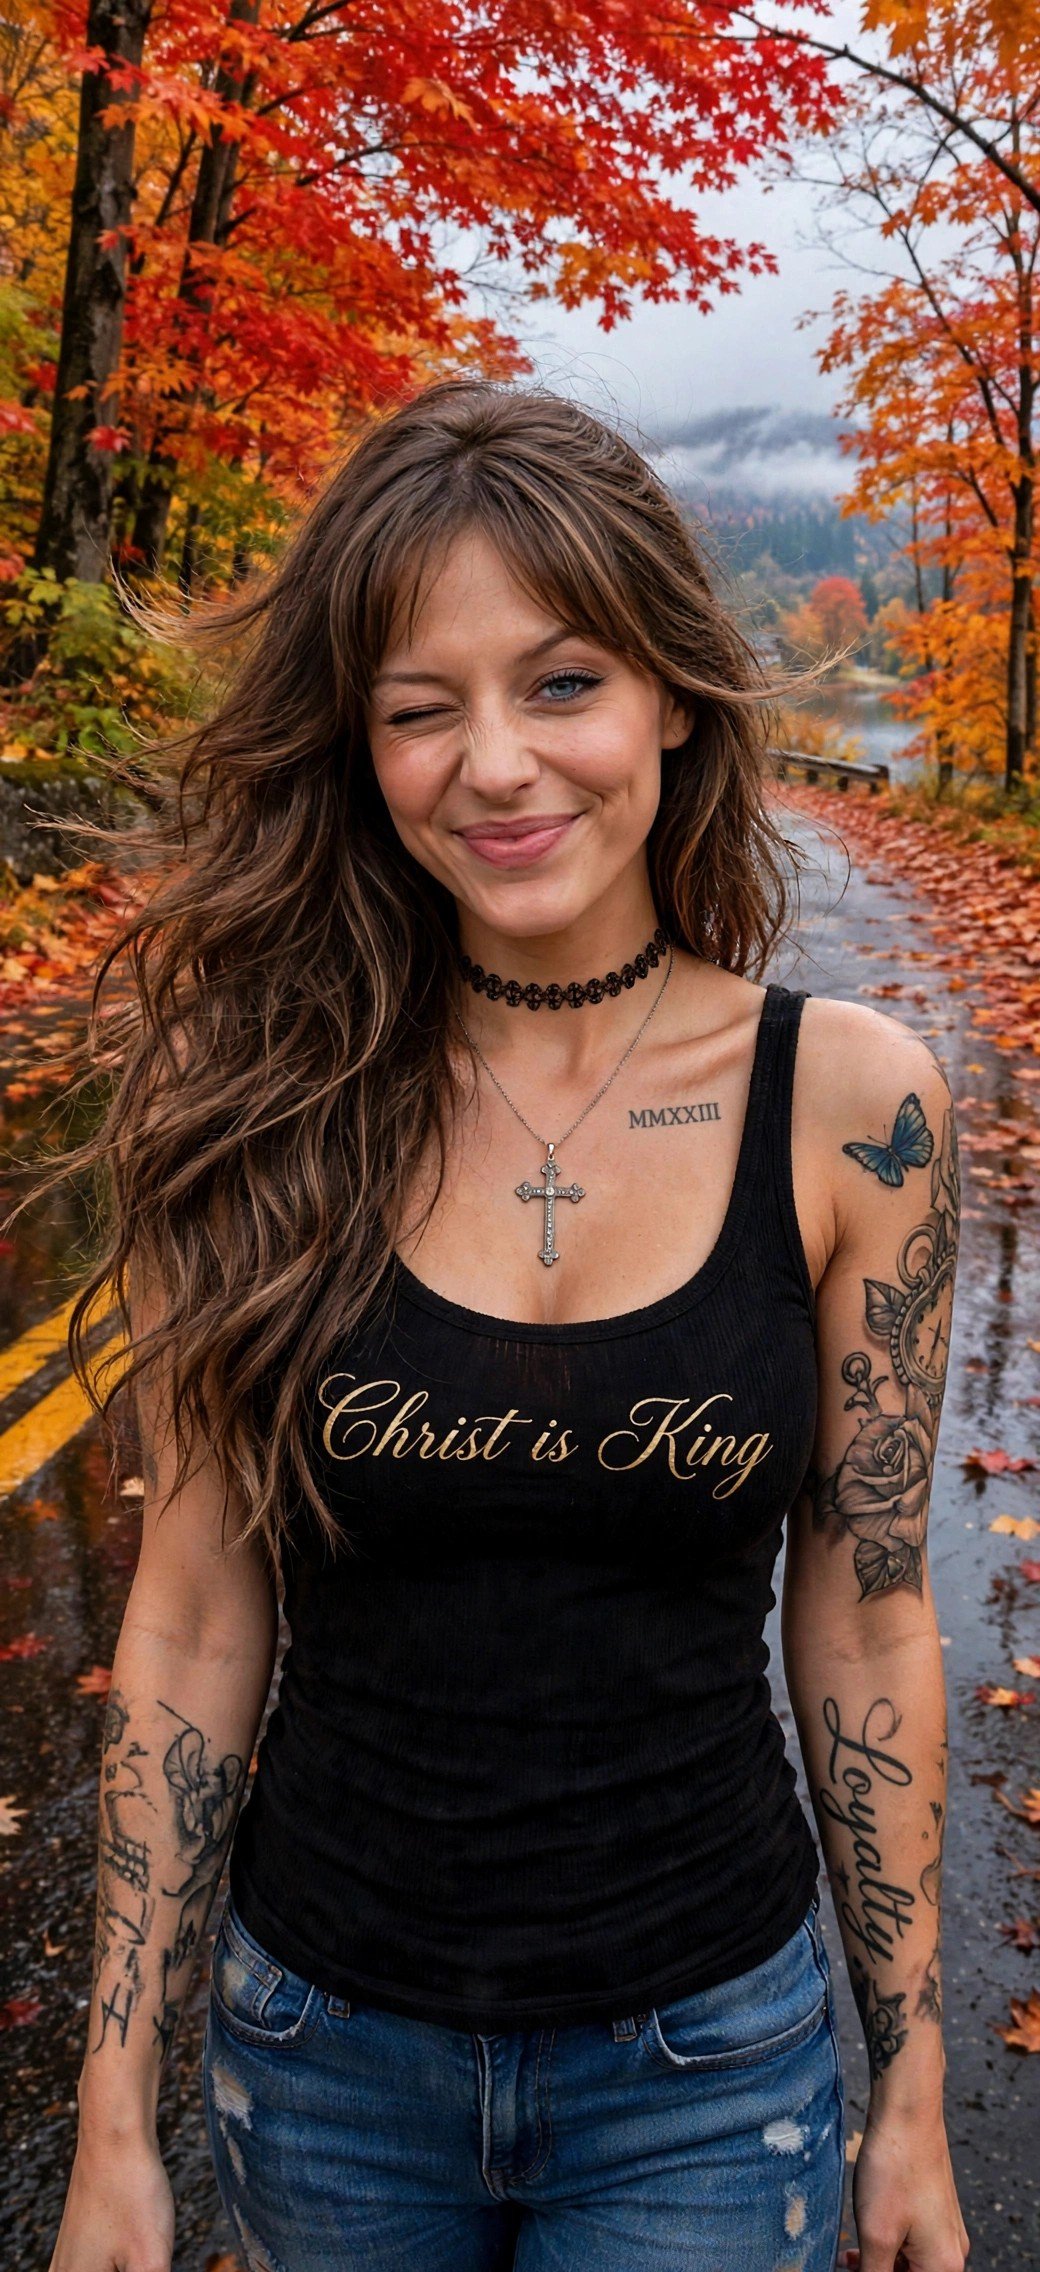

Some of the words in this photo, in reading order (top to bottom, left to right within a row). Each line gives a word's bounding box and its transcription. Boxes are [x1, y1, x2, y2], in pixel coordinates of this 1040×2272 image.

[628, 1102, 722, 1129] MMXXIII
[318, 1372, 533, 1461] Christ
[530, 1419, 579, 1463] is
[598, 1393, 774, 1500] King
[819, 1697, 916, 1966] Loyalty
